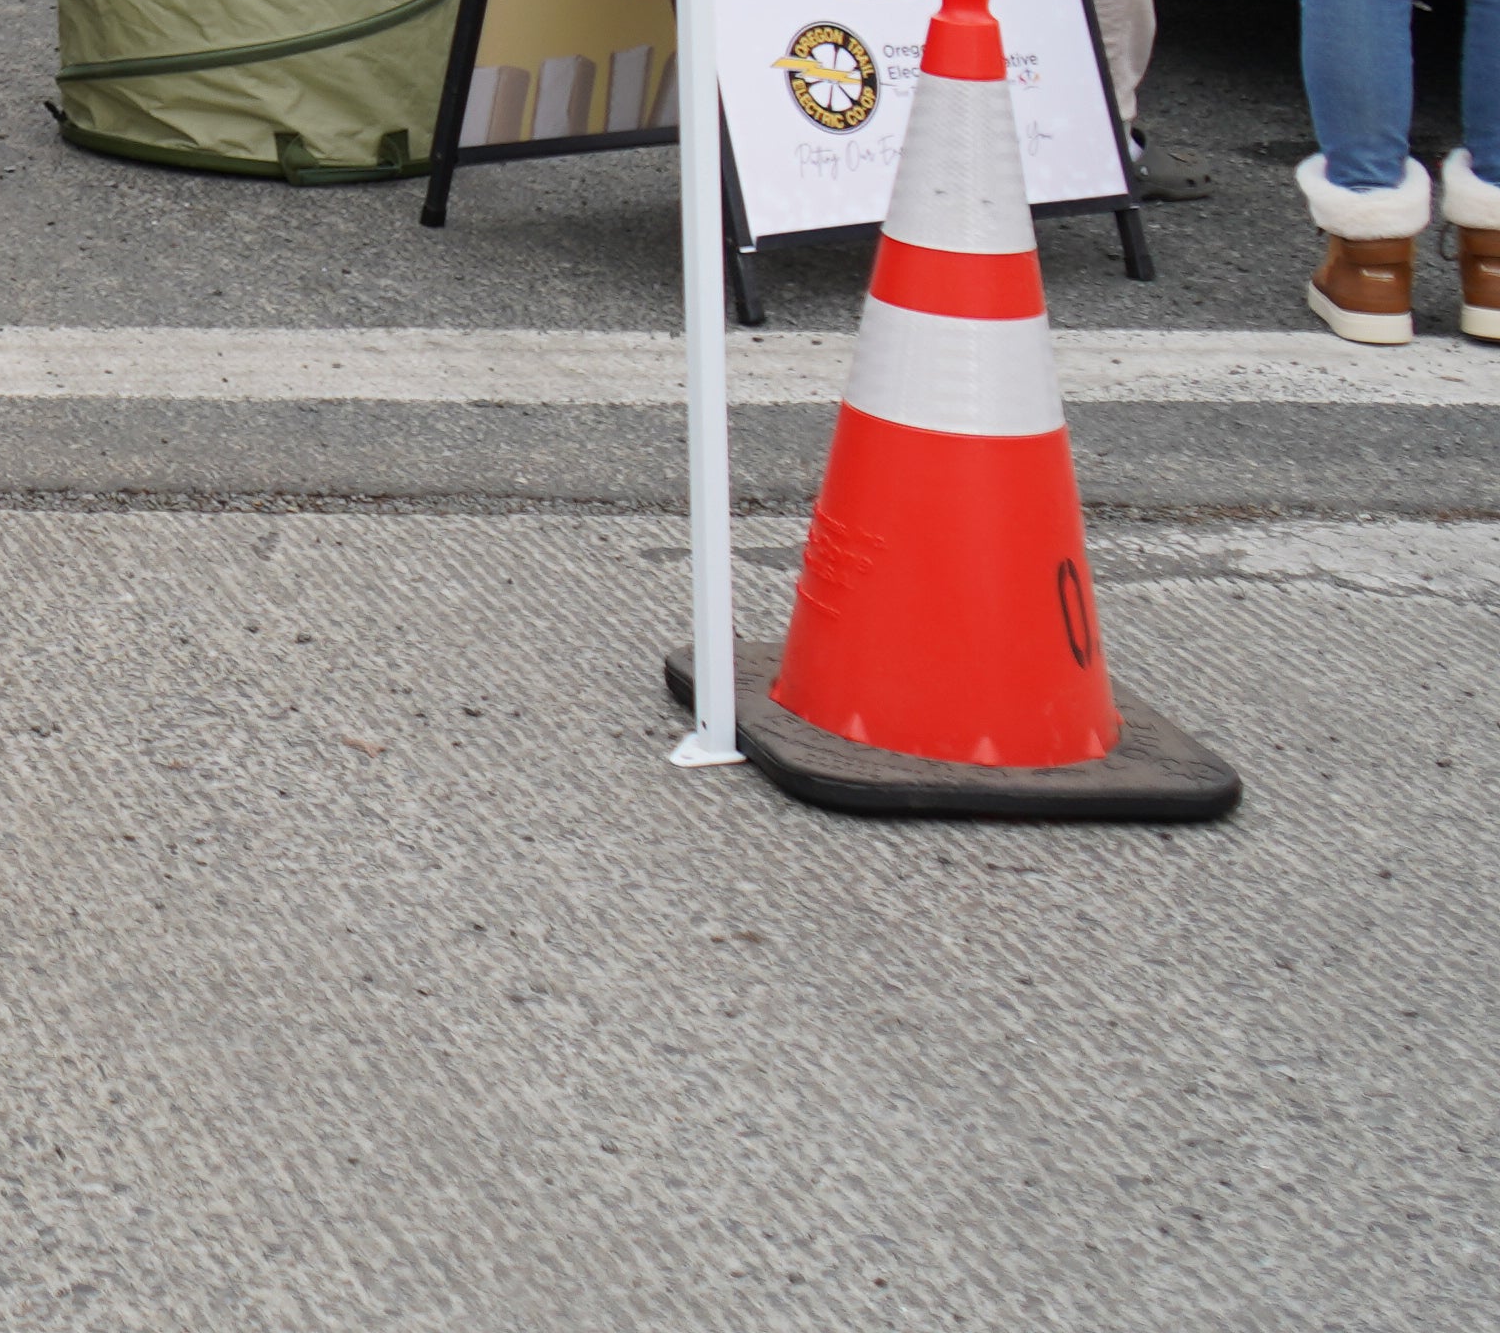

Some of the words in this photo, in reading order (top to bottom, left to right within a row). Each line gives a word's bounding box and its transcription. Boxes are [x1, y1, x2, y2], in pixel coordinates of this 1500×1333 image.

[794, 26, 845, 59] OREGON
[846, 36, 877, 80] TRAIL
[791, 78, 845, 130] ELECTRIC
[845, 86, 877, 127] CO-OP
